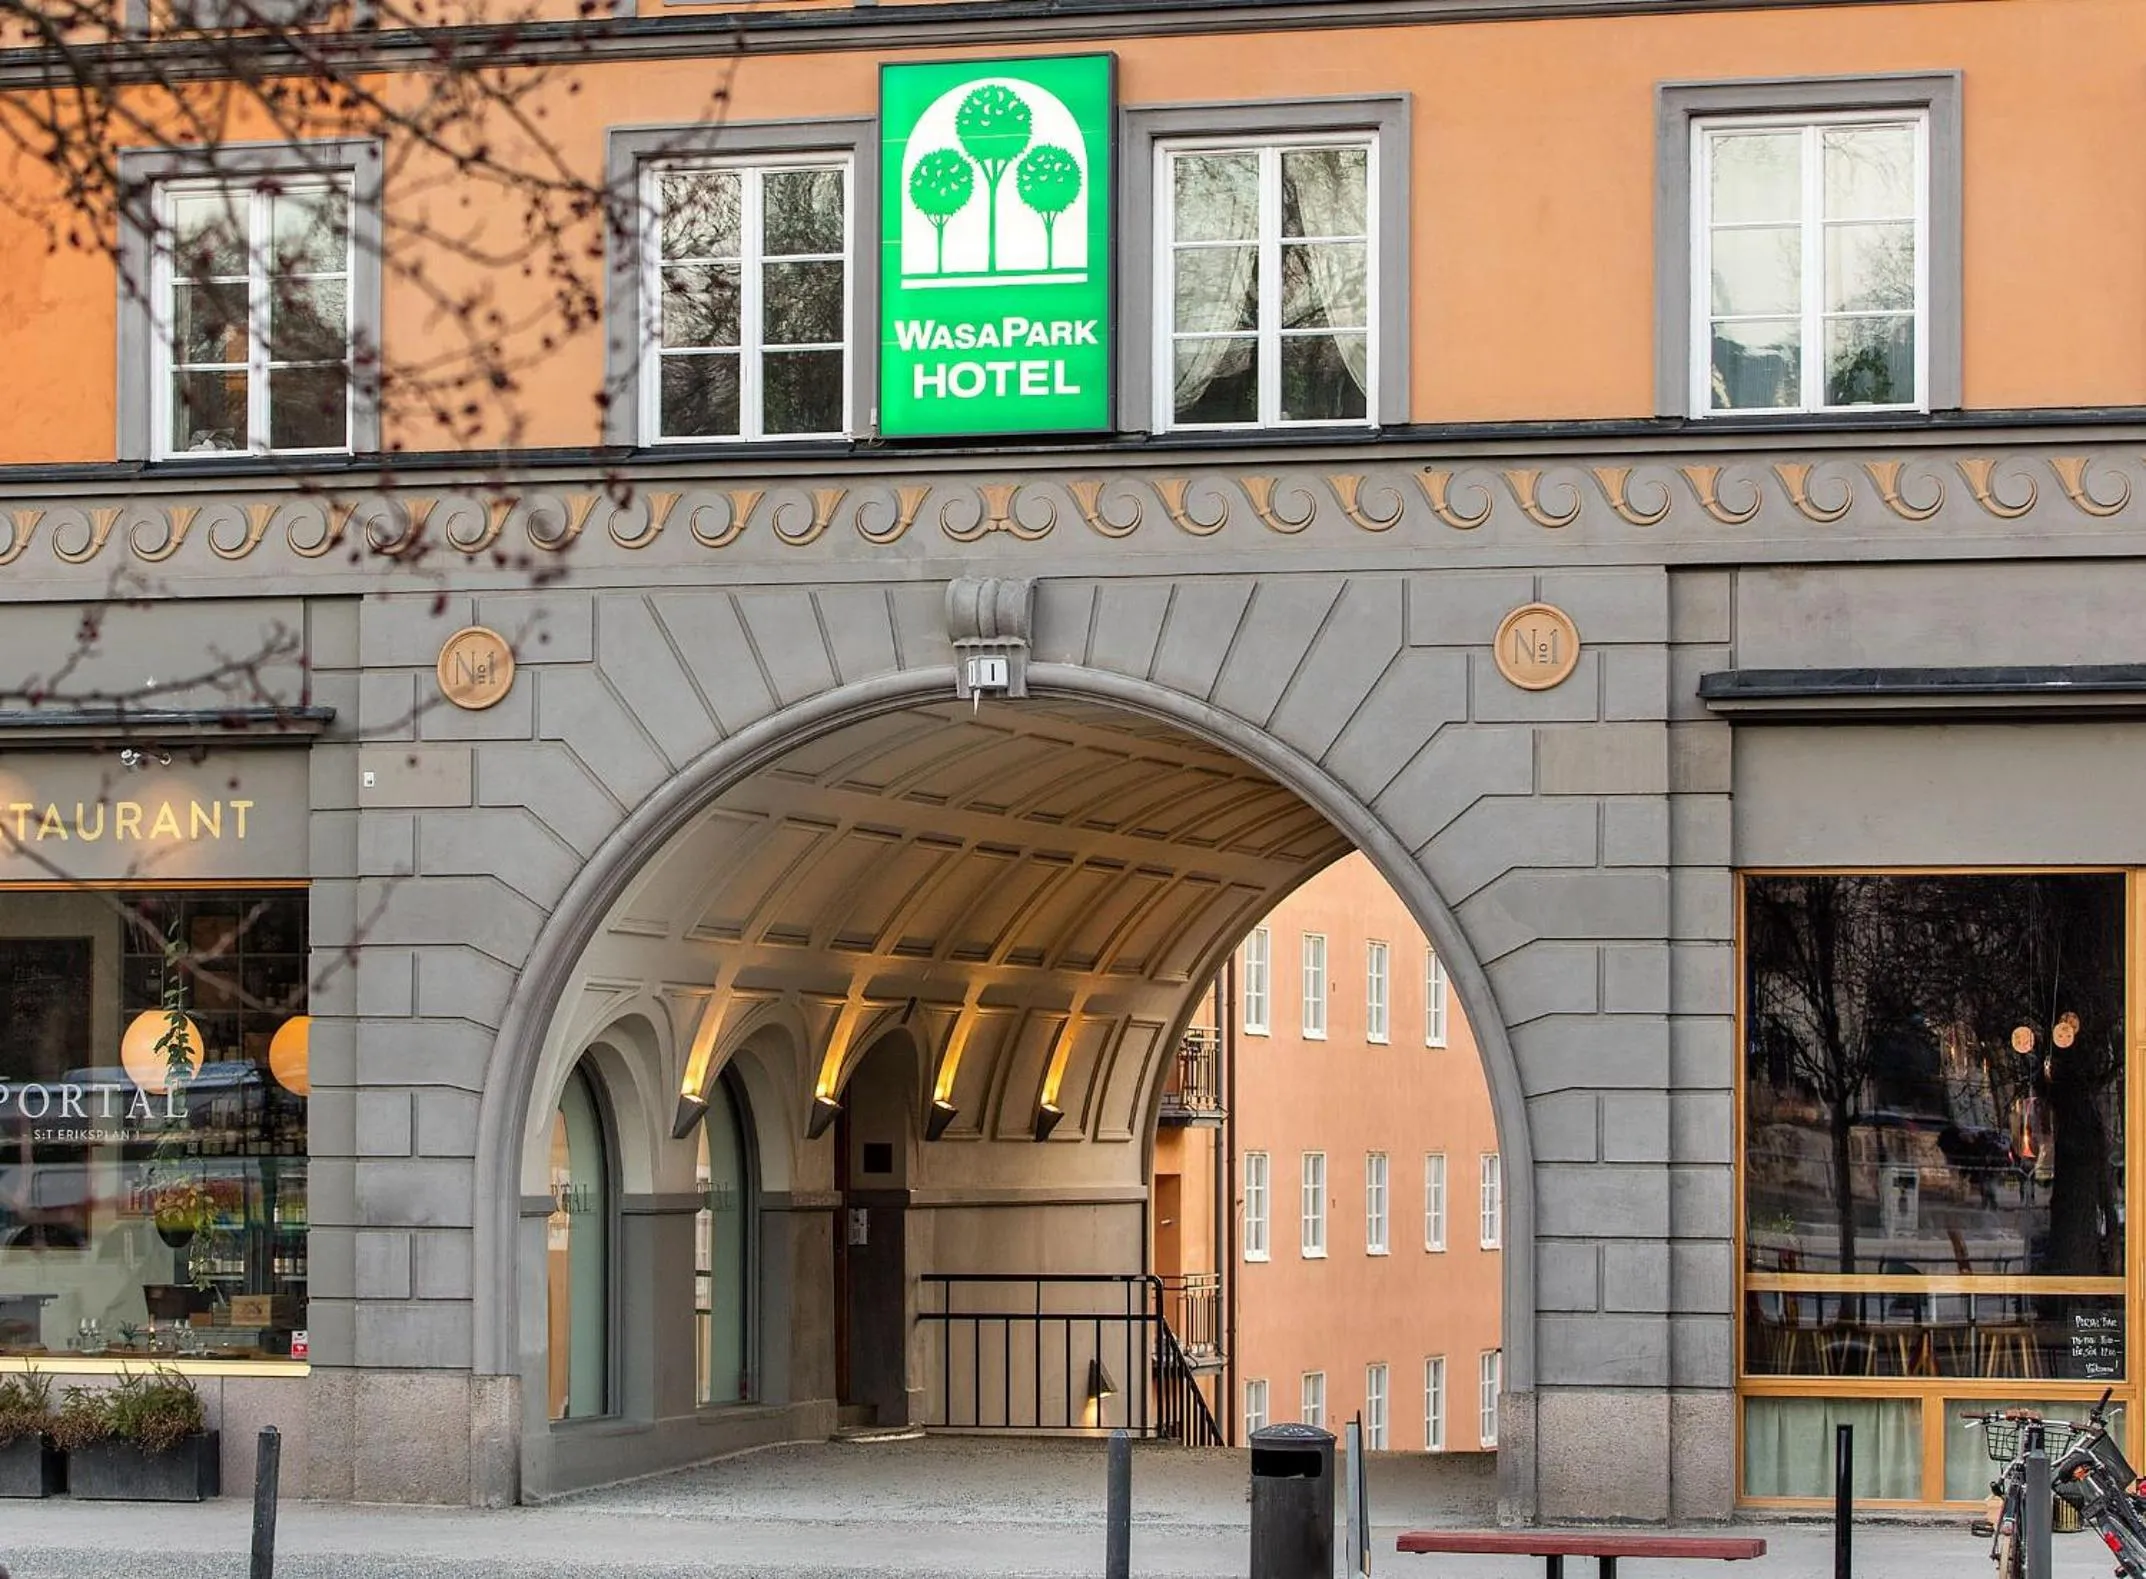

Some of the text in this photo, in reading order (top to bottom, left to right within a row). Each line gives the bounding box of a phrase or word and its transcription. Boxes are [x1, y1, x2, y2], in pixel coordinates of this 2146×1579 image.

[913, 360, 1081, 400] HOTEL
[0, 800, 254, 842] TAURANT
[58, 1129, 130, 1141] ERIKSPLAN
